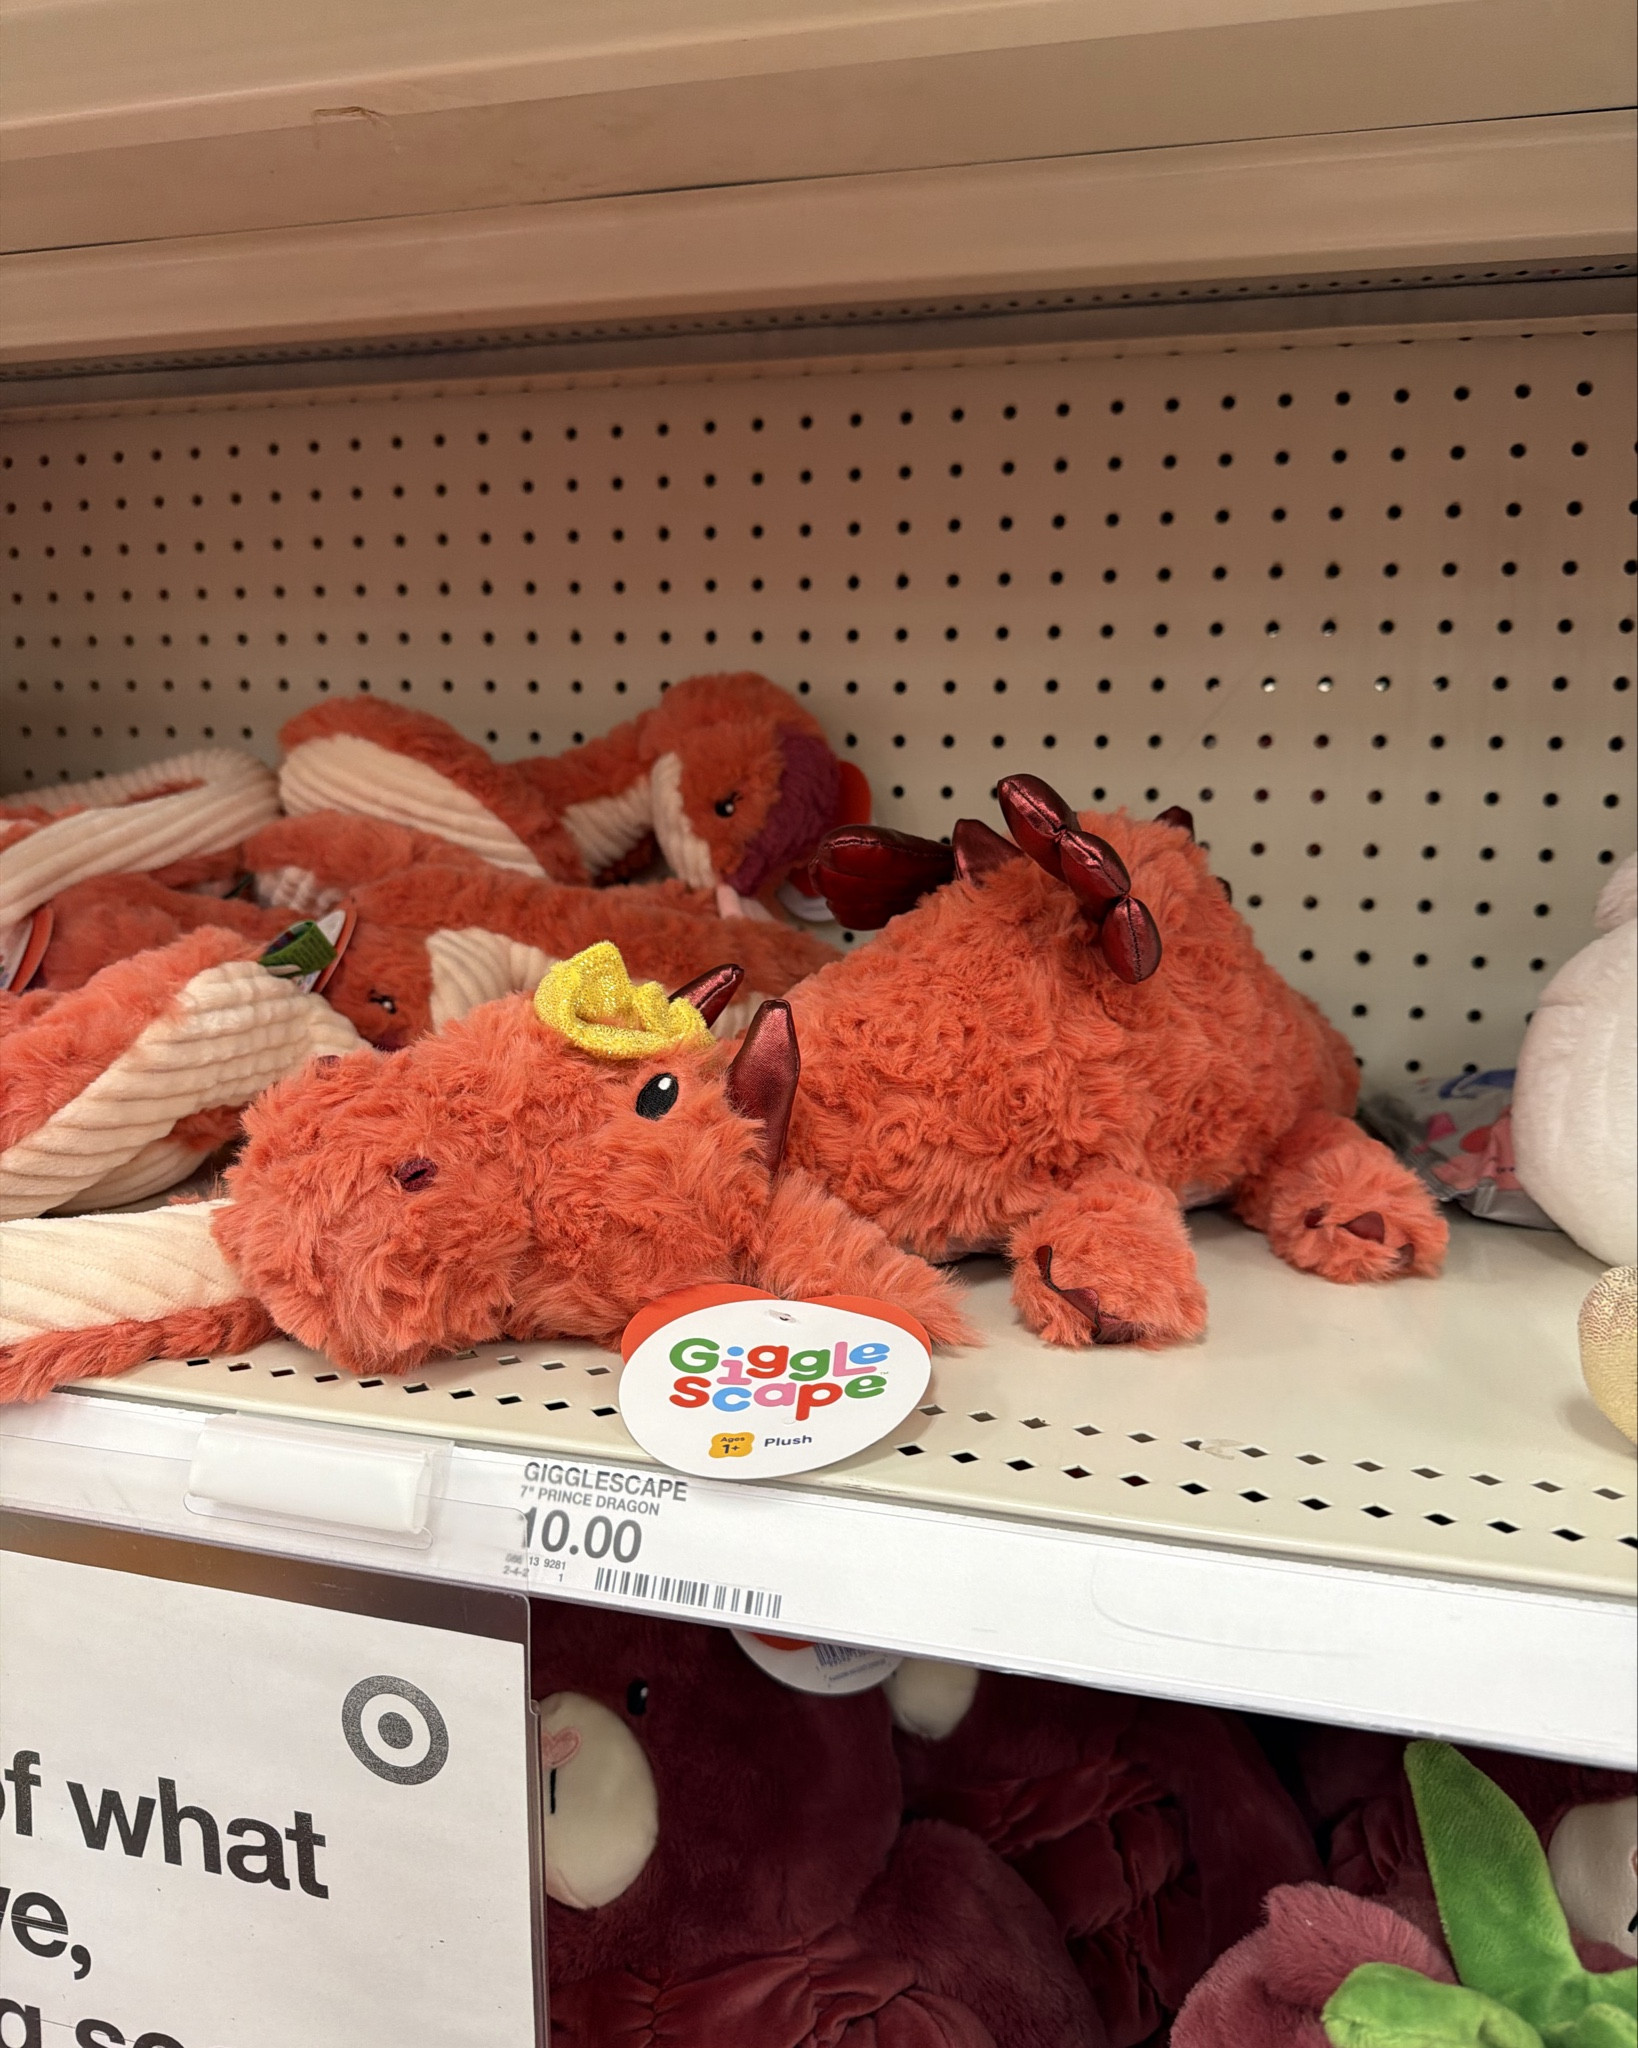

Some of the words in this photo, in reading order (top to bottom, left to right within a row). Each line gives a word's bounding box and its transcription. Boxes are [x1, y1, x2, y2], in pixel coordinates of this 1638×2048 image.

[722, 1444, 741, 1455] 1+
[764, 1435, 813, 1448] Plush
[523, 1461, 689, 1502] GIGGLESCAPE
[519, 1485, 535, 1498] 7"
[537, 1487, 593, 1507] PRINCE
[596, 1495, 661, 1516] DRAGON
[543, 1558, 567, 1571] 9281
[0, 1749, 42, 1838] f
[66, 1776, 330, 1901] what
